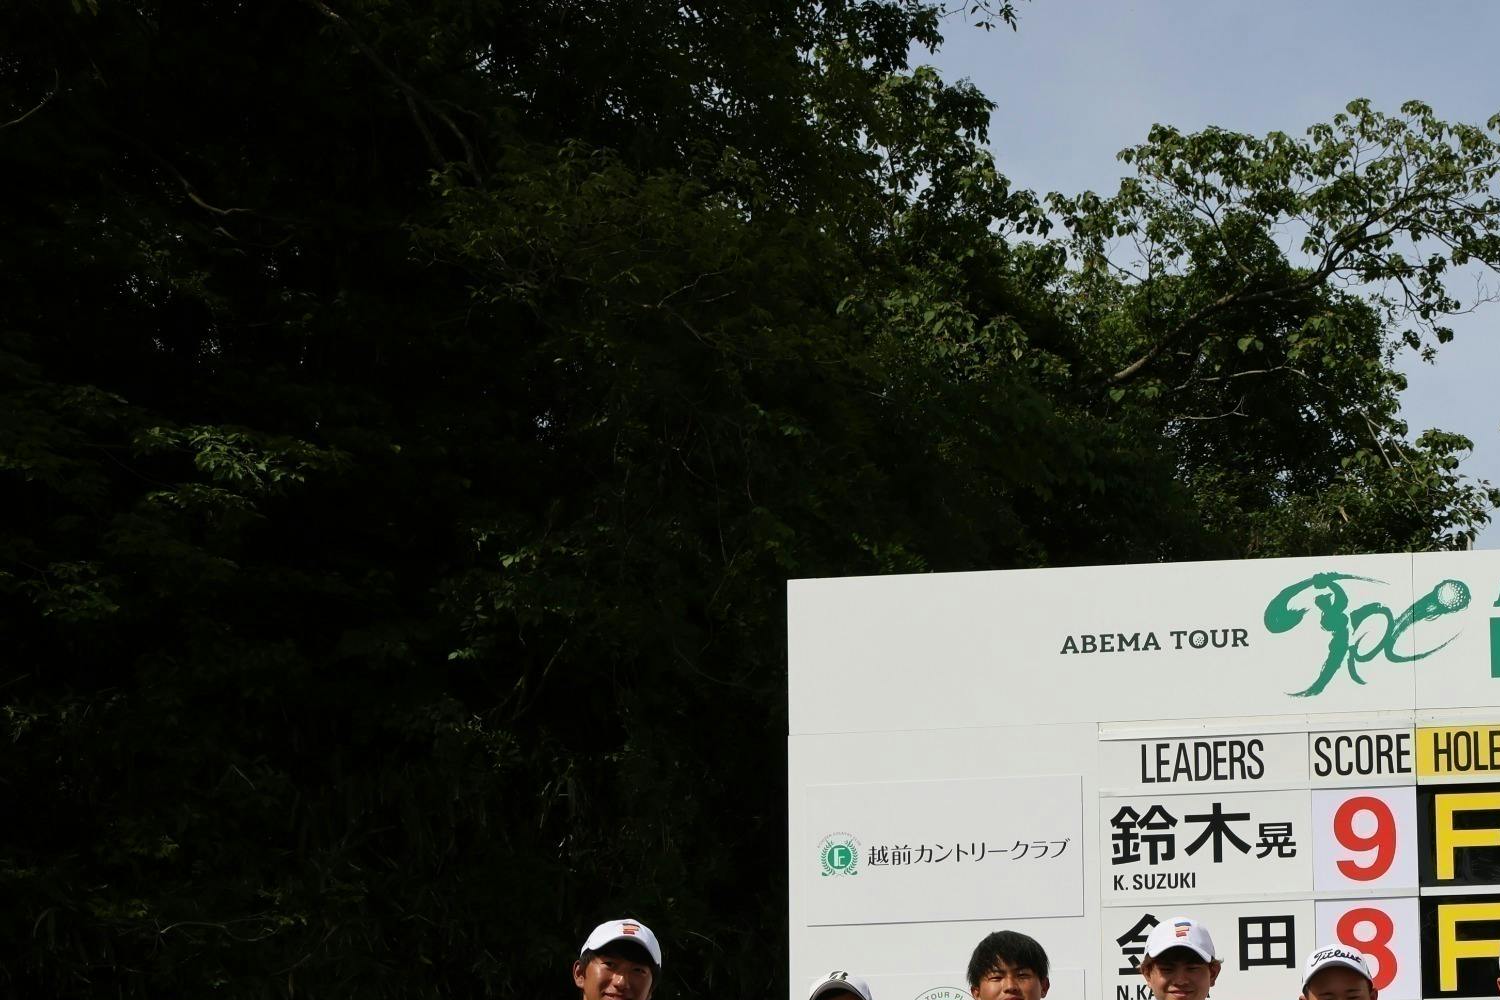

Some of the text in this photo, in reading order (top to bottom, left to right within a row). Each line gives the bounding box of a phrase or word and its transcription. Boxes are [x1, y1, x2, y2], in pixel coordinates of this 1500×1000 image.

[1060, 628, 1250, 654] ABEMA TOUR
[1141, 738, 1265, 783] LEADERS
[1314, 733, 1412, 777] SCORE
[867, 838, 1071, 867] 越前カントリークラブ
[1110, 802, 1297, 866] 鈴木晃
[1333, 796, 1397, 881] 9
[1113, 872, 1196, 891] K. SUZUKI
[1311, 949, 1361, 967] Titleist
[1336, 907, 1398, 991] 8
